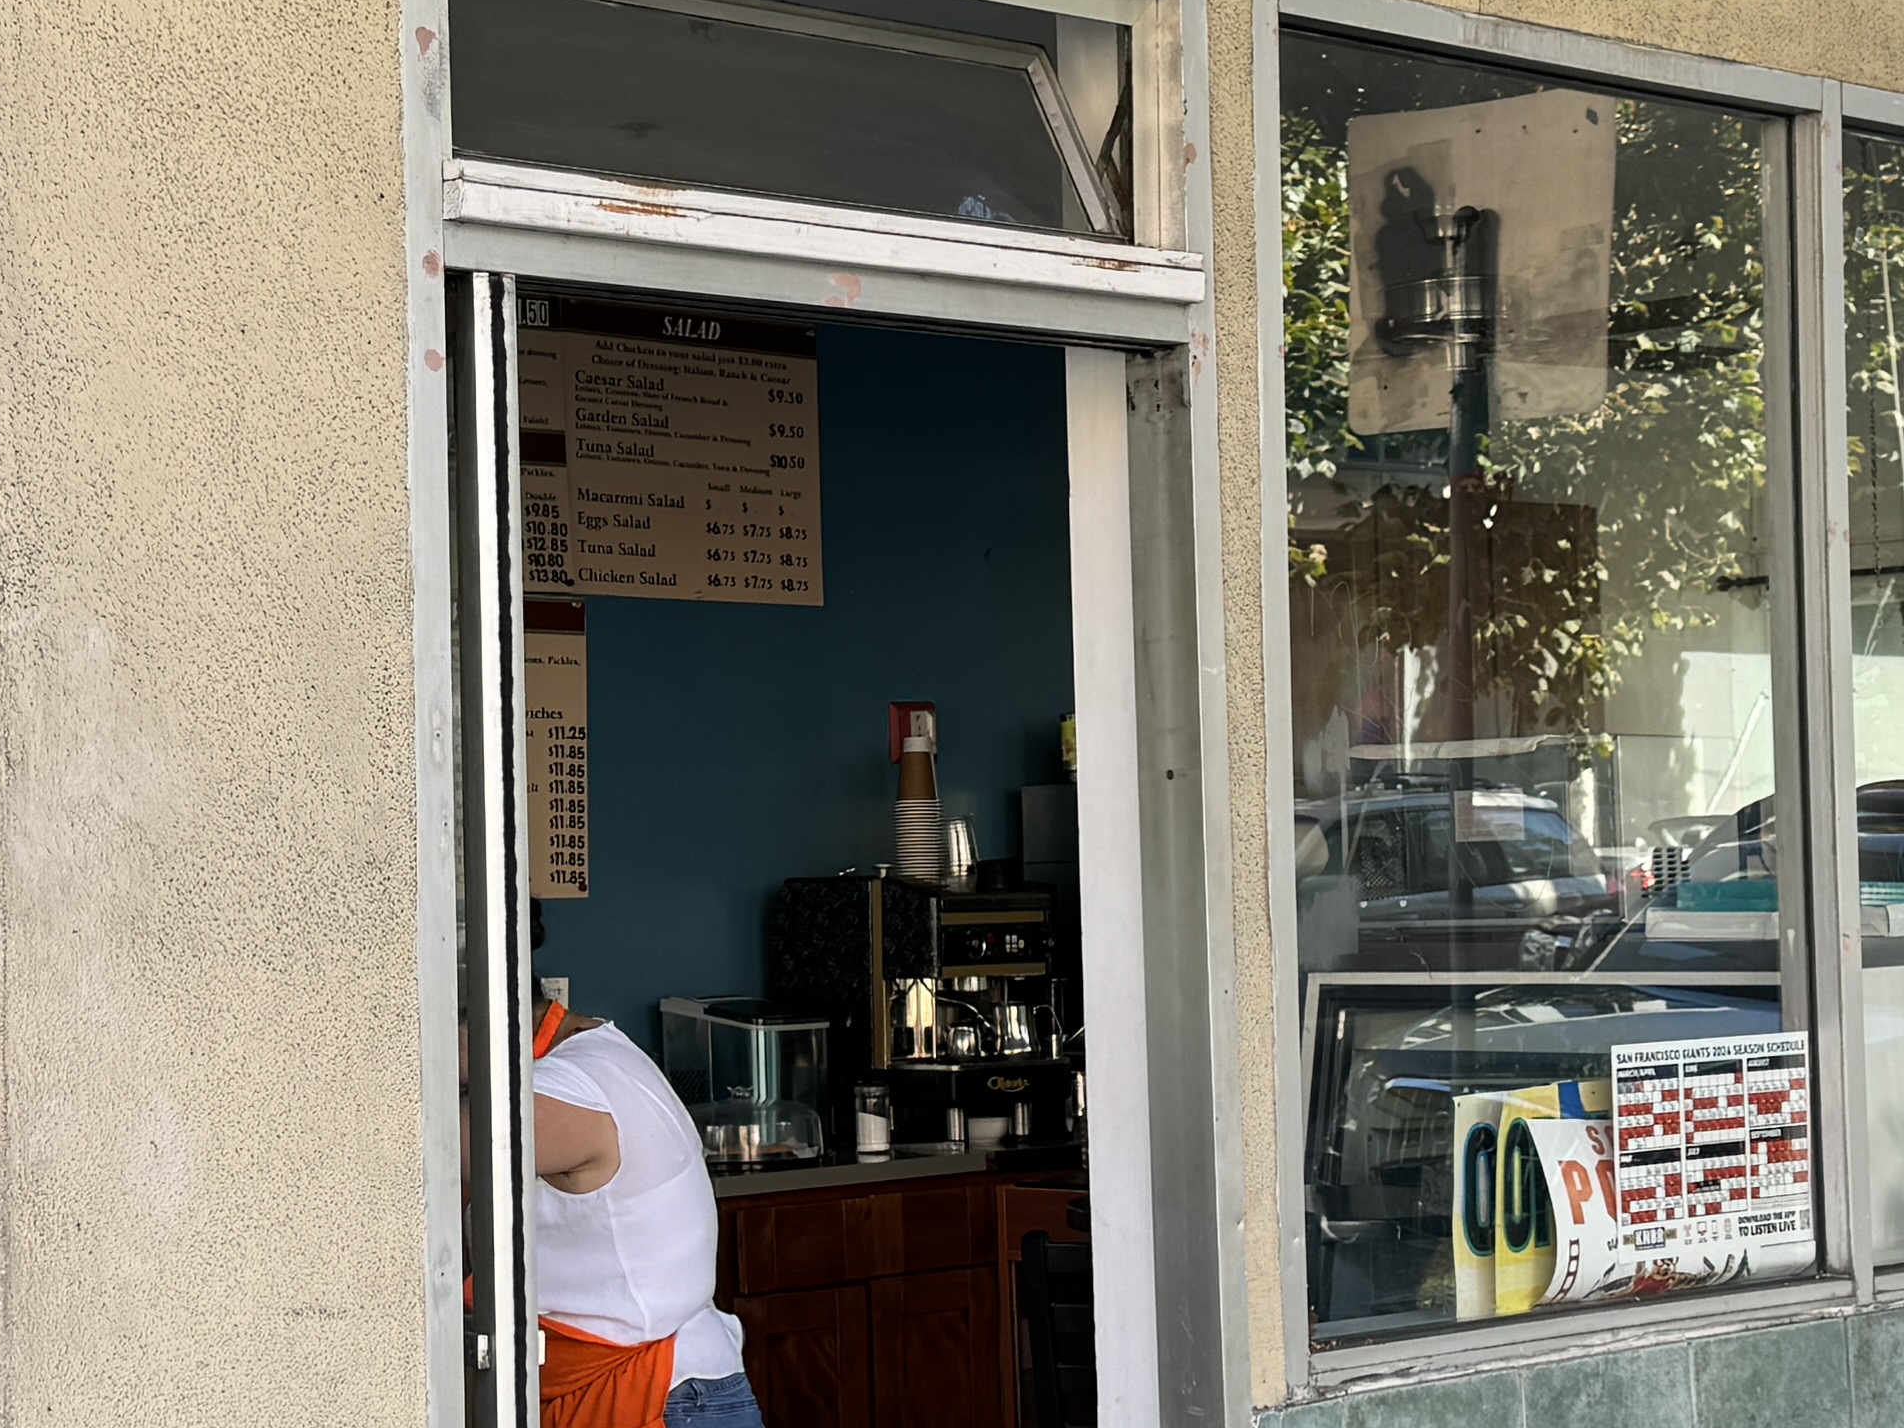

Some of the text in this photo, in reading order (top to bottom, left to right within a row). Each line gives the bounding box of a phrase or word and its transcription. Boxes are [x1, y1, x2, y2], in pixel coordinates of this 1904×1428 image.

[662, 316, 721, 340] SALAD
[616, 342, 654, 355] Chicken
[575, 370, 803, 404] Caesar Salad $9.50
[575, 407, 804, 438] Garden Salad $9.50
[576, 438, 612, 453] Tuna
[616, 441, 654, 457] Salad
[577, 487, 643, 505] Macaroni
[647, 493, 685, 509] Salad
[526, 521, 568, 537] $10.80
[578, 511, 608, 531] Eggs
[613, 514, 650, 529] Salad
[743, 524, 771, 537] $7.75
[526, 536, 568, 553] $12.85
[577, 539, 614, 554] Tuna
[618, 542, 656, 557] Salad
[743, 550, 772, 564] $7.75
[578, 567, 634, 584] Chicken
[639, 571, 677, 586] Salad
[744, 575, 773, 589] $7.75
[548, 726, 585, 740] $11.25
[548, 744, 585, 760] $11.85
[549, 762, 585, 778] $11.85
[549, 780, 585, 794] $11.85
[549, 798, 585, 814] $11.85
[549, 815, 585, 830] $11.85
[549, 833, 585, 849] $11.85
[549, 851, 585, 867] $11.85
[549, 869, 585, 885] $11.85
[1617, 1052, 1633, 1064] SAN
[1635, 1050, 1680, 1063] FRANCISCO
[1683, 1047, 1710, 1059] GIANTS
[1733, 1043, 1764, 1056] SEASON
[1738, 1214, 1771, 1225] DOWNLOAD
[1739, 1220, 1797, 1237] TO LISTEN LIVE
